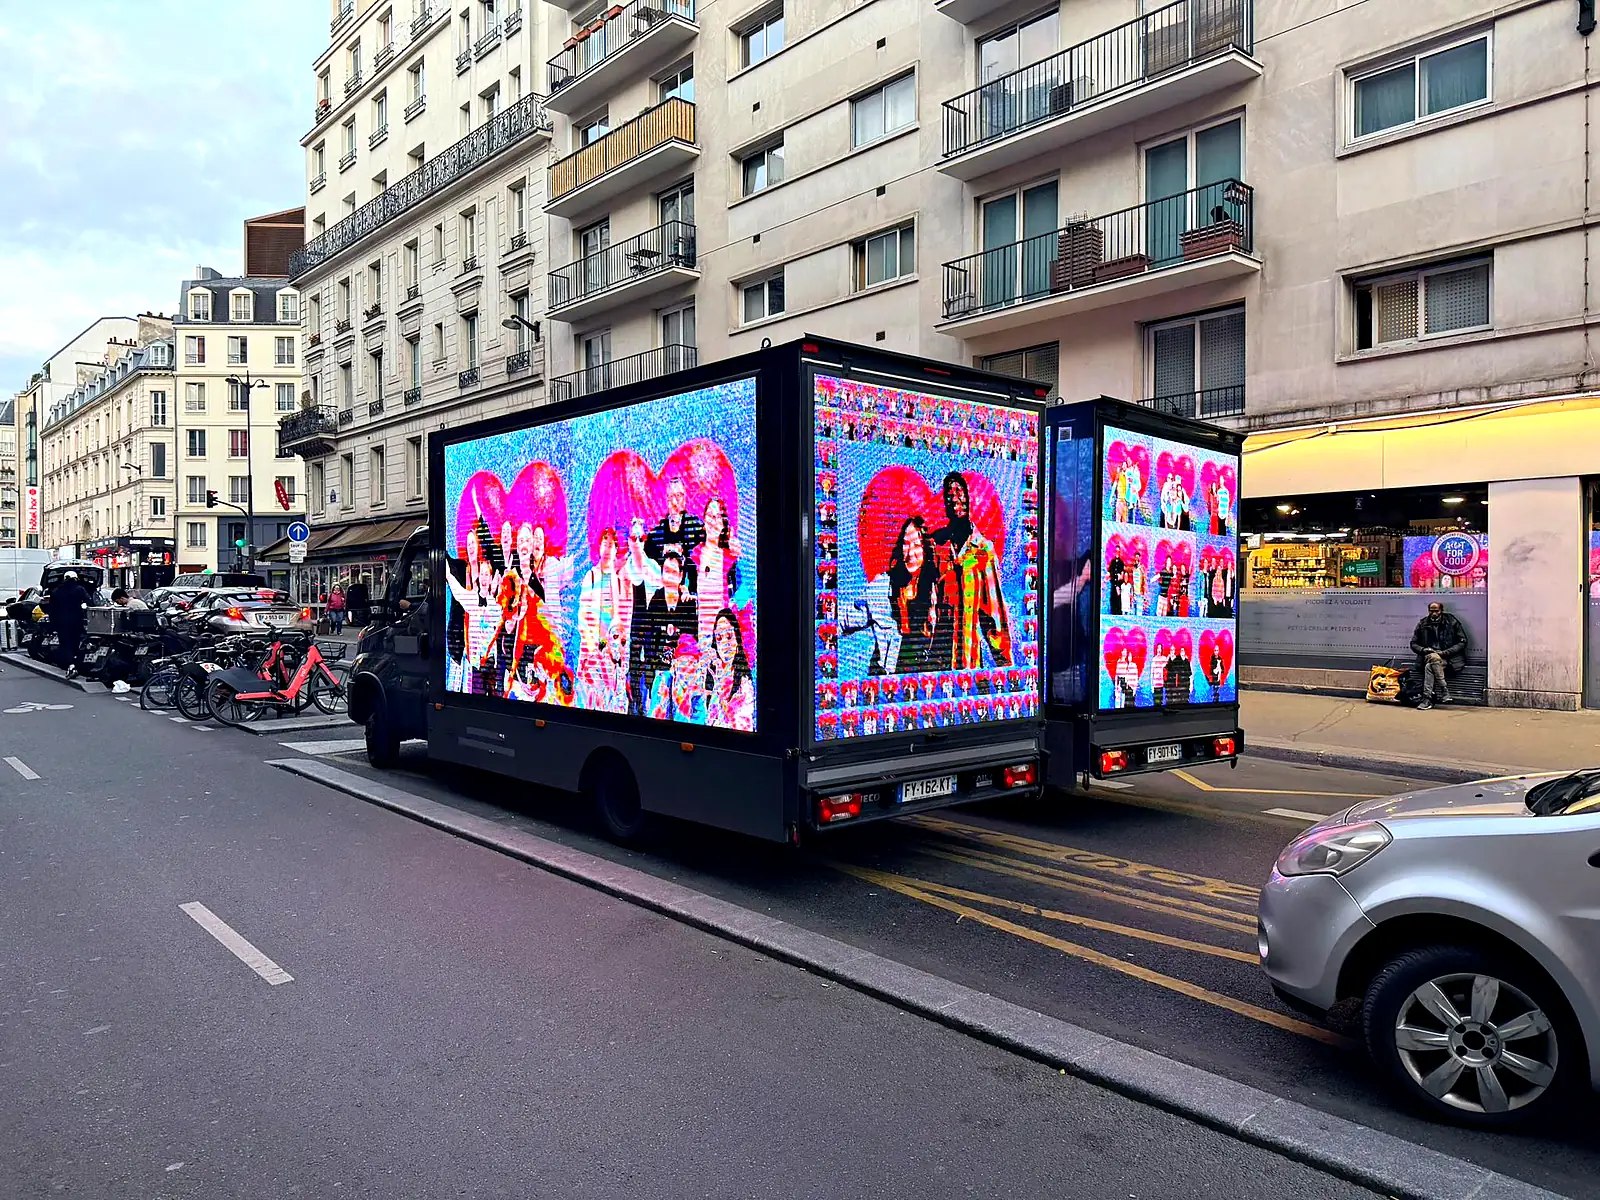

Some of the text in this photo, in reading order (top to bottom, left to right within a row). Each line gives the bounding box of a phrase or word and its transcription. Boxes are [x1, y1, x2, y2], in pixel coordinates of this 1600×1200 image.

[1447, 549, 1463, 557] FOR
[1444, 557, 1466, 566] FOOD
[904, 776, 951, 798] FY-162-KT
[861, 793, 880, 803] ECO
